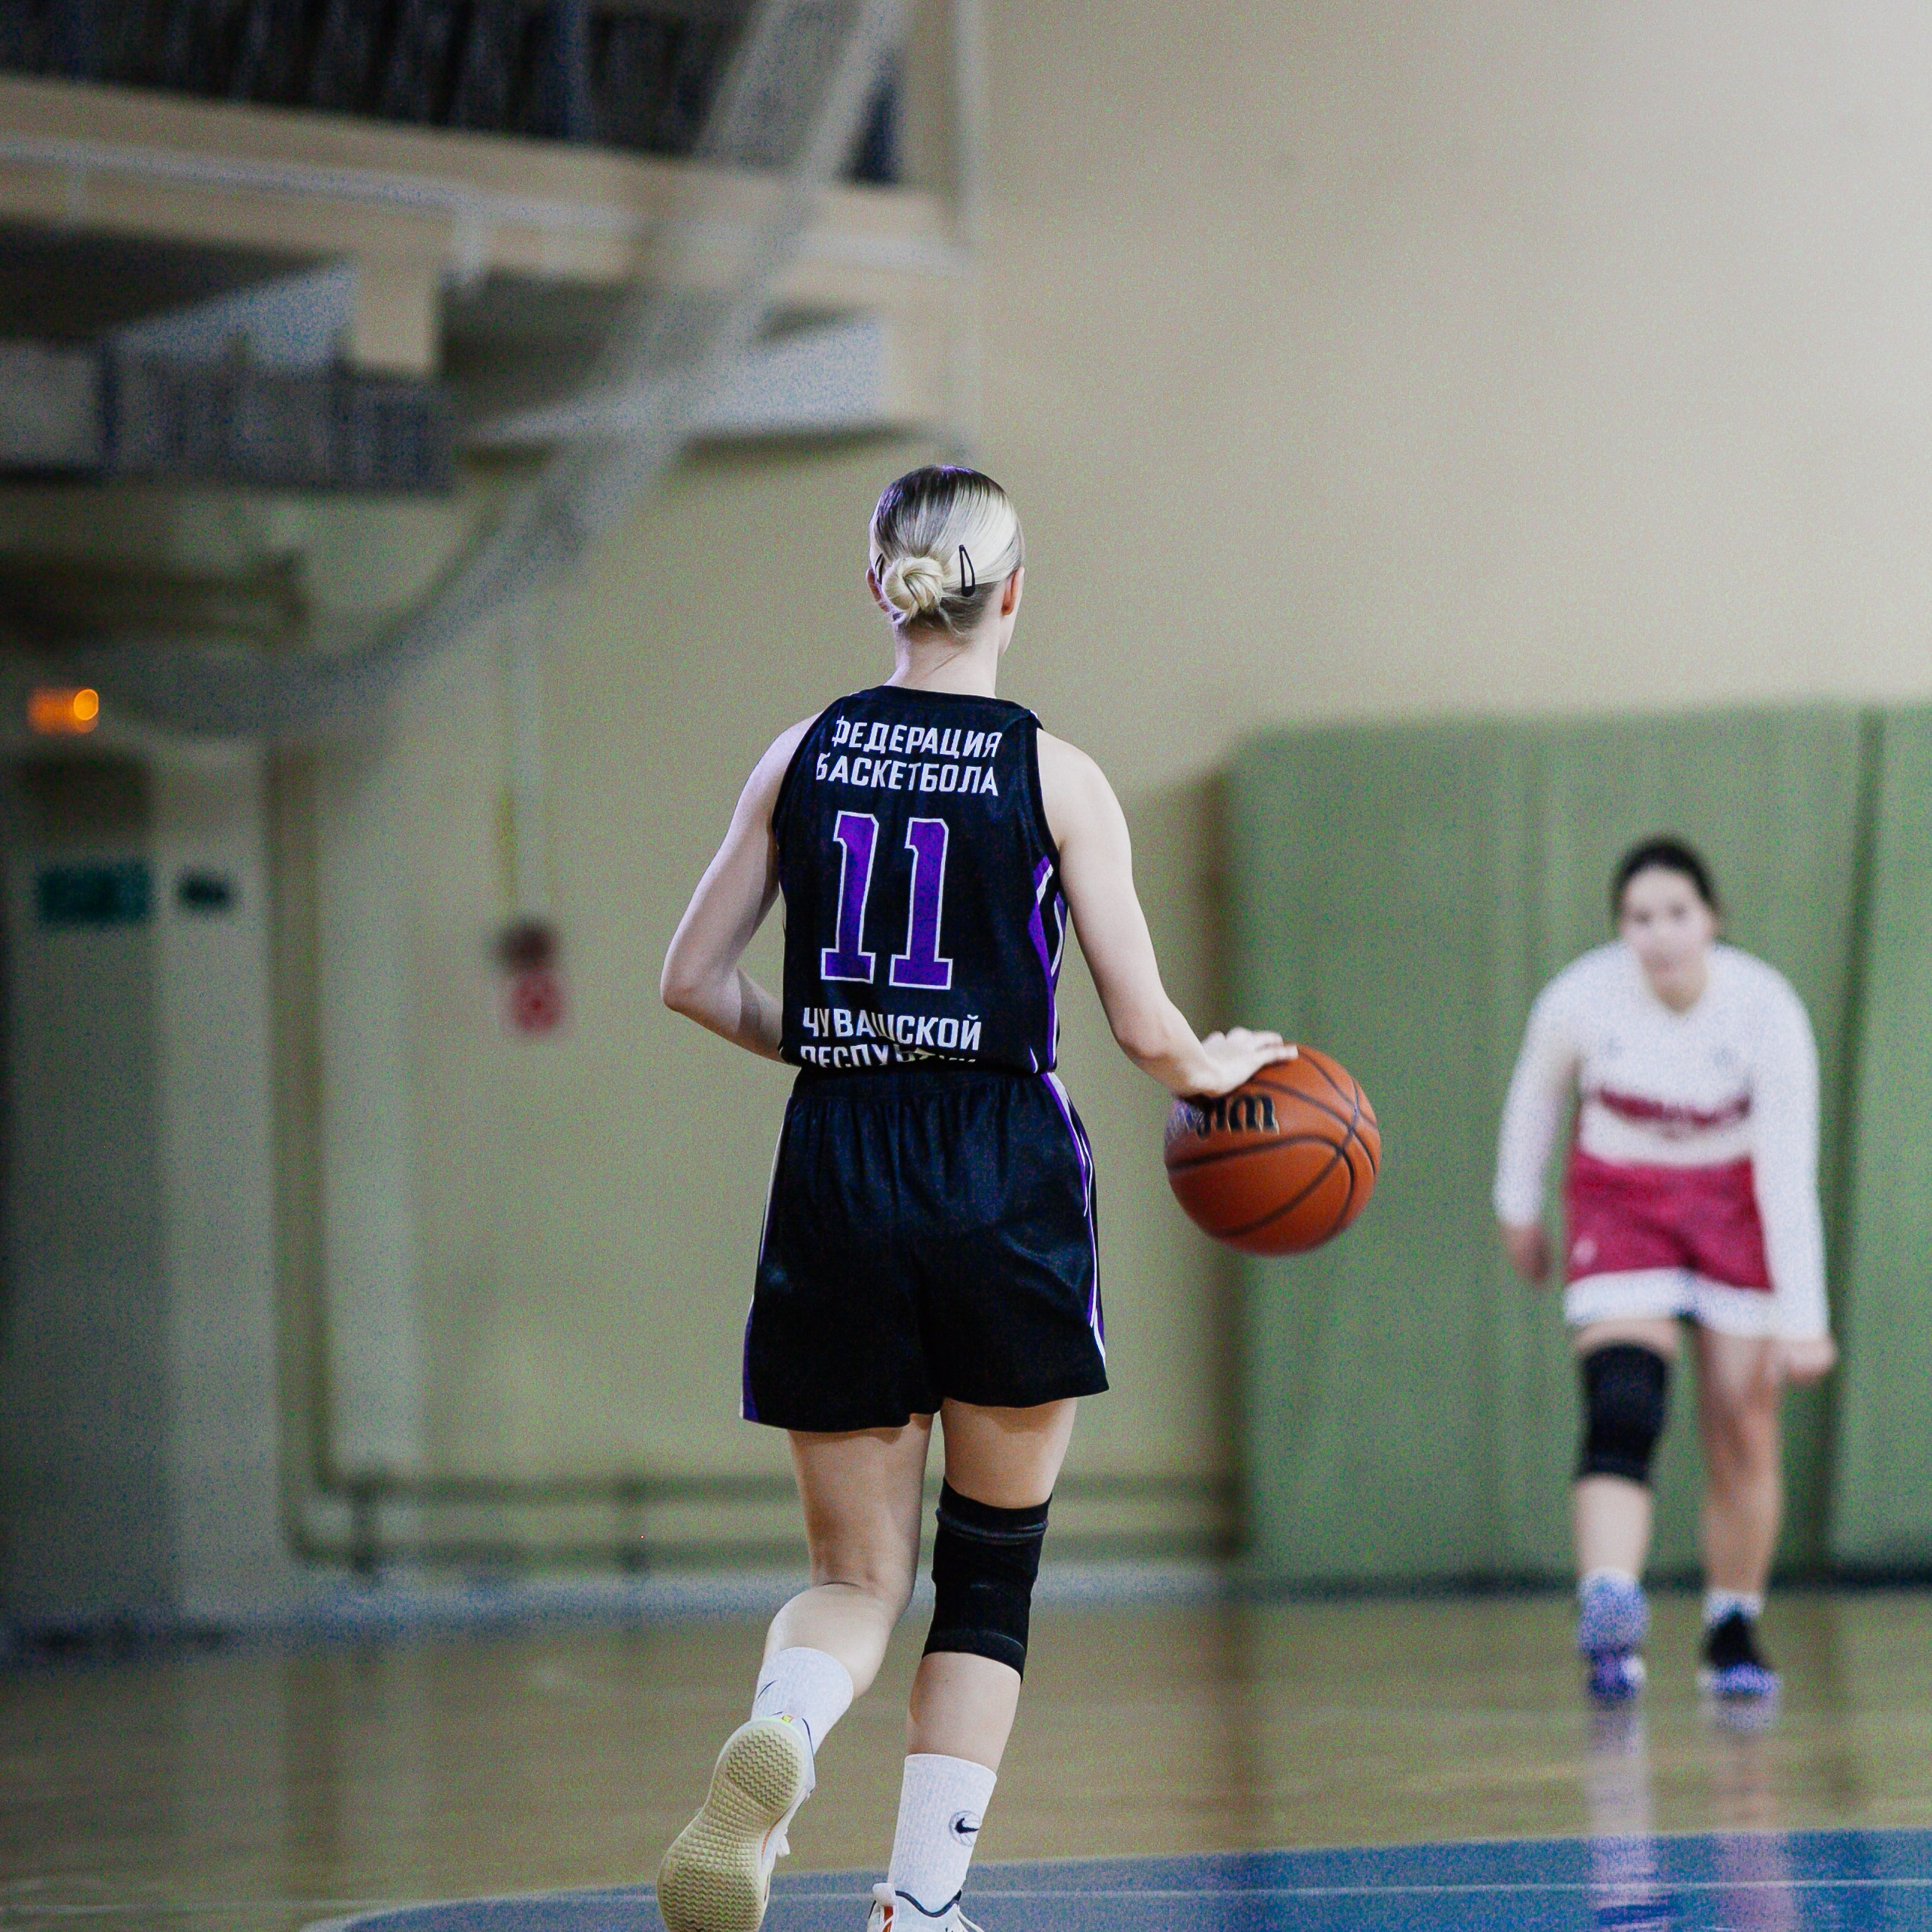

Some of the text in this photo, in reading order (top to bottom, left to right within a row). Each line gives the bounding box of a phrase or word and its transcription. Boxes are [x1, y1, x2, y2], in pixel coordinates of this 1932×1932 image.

[832, 715, 1002, 758] ФЕДЕРАЦИЯ
[816, 752, 998, 796] БАСКЕТБОЛА
[820, 811, 953, 990] 11
[802, 1007, 981, 1051] ЧУВАШСКОЙ
